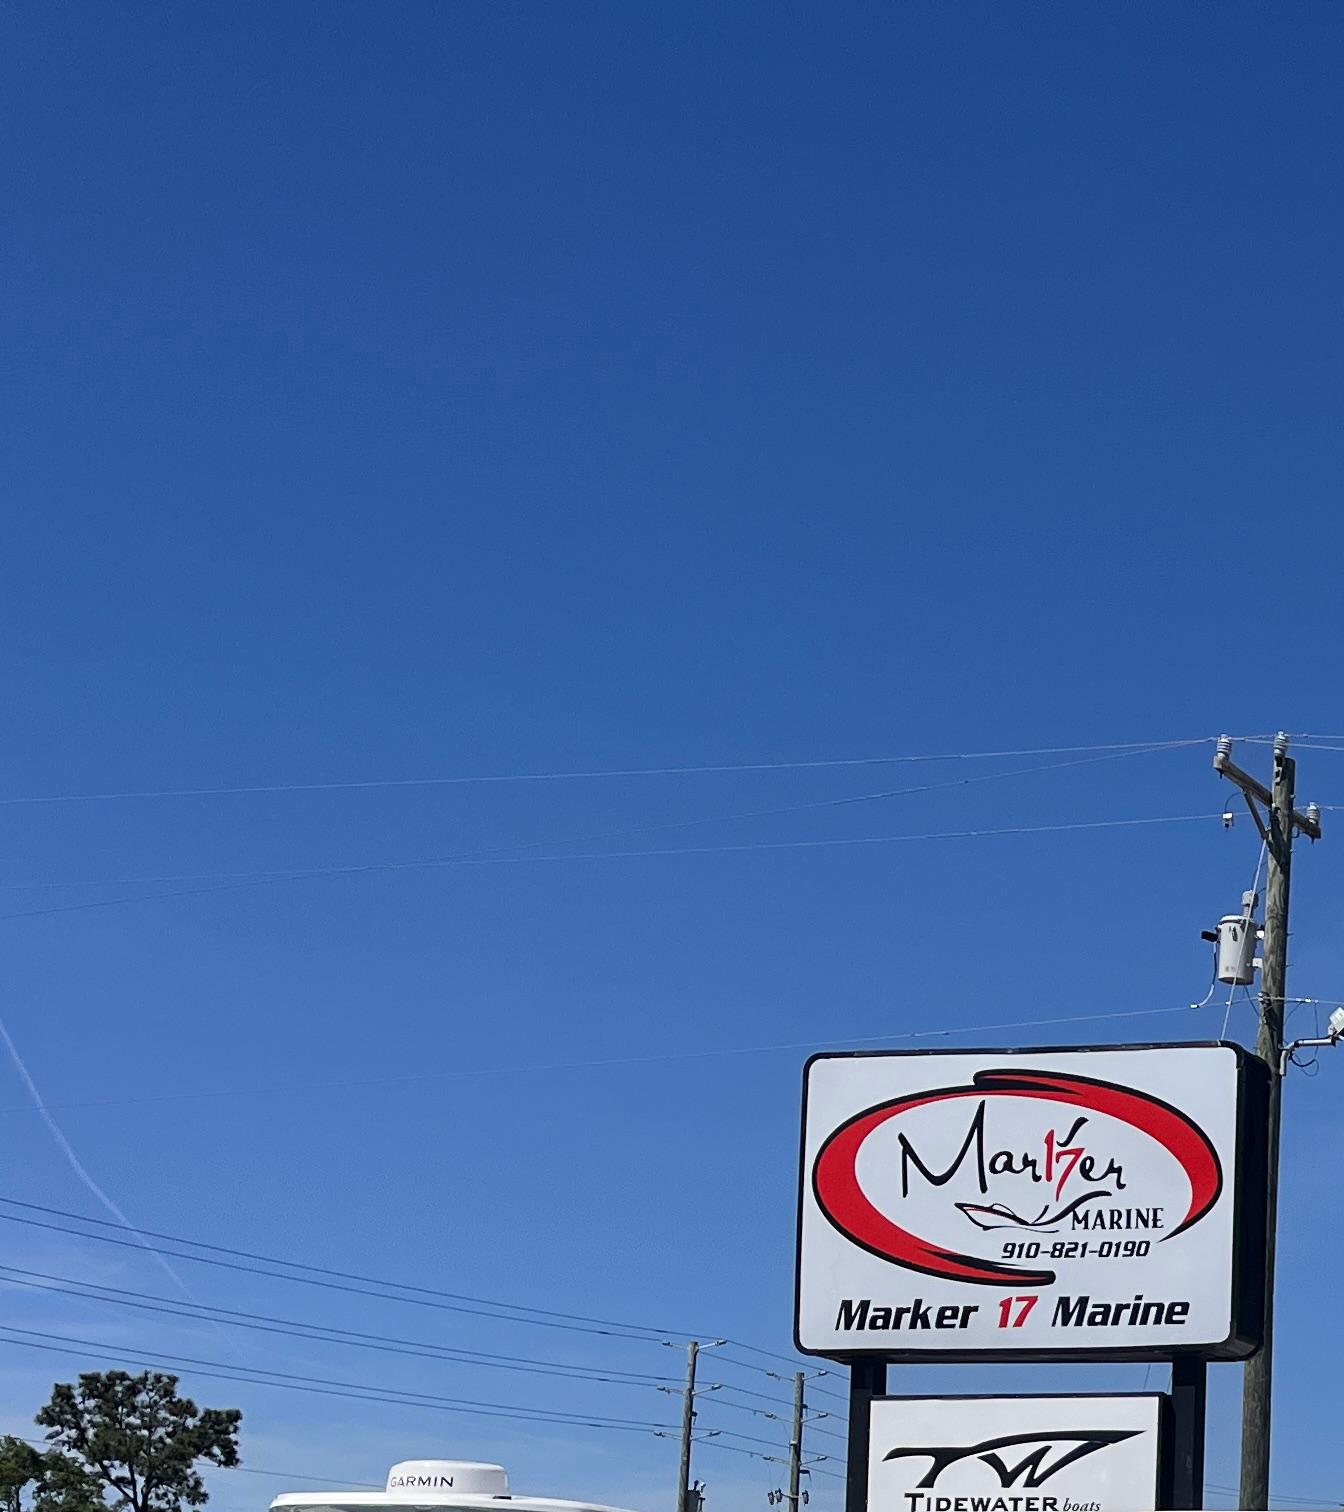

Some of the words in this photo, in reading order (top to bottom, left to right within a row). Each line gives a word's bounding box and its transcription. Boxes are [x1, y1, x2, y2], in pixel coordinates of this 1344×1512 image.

[1071, 1207, 1164, 1231] MARINE
[1001, 1240, 1151, 1259] 910-821-0190
[834, 1298, 979, 1331] Marker
[998, 1295, 1039, 1328] 17
[1051, 1294, 1191, 1328] Marine
[390, 1476, 454, 1488] GARMIN
[904, 1492, 1059, 1512] TIDEWATER
[1063, 1497, 1101, 1512] boats
